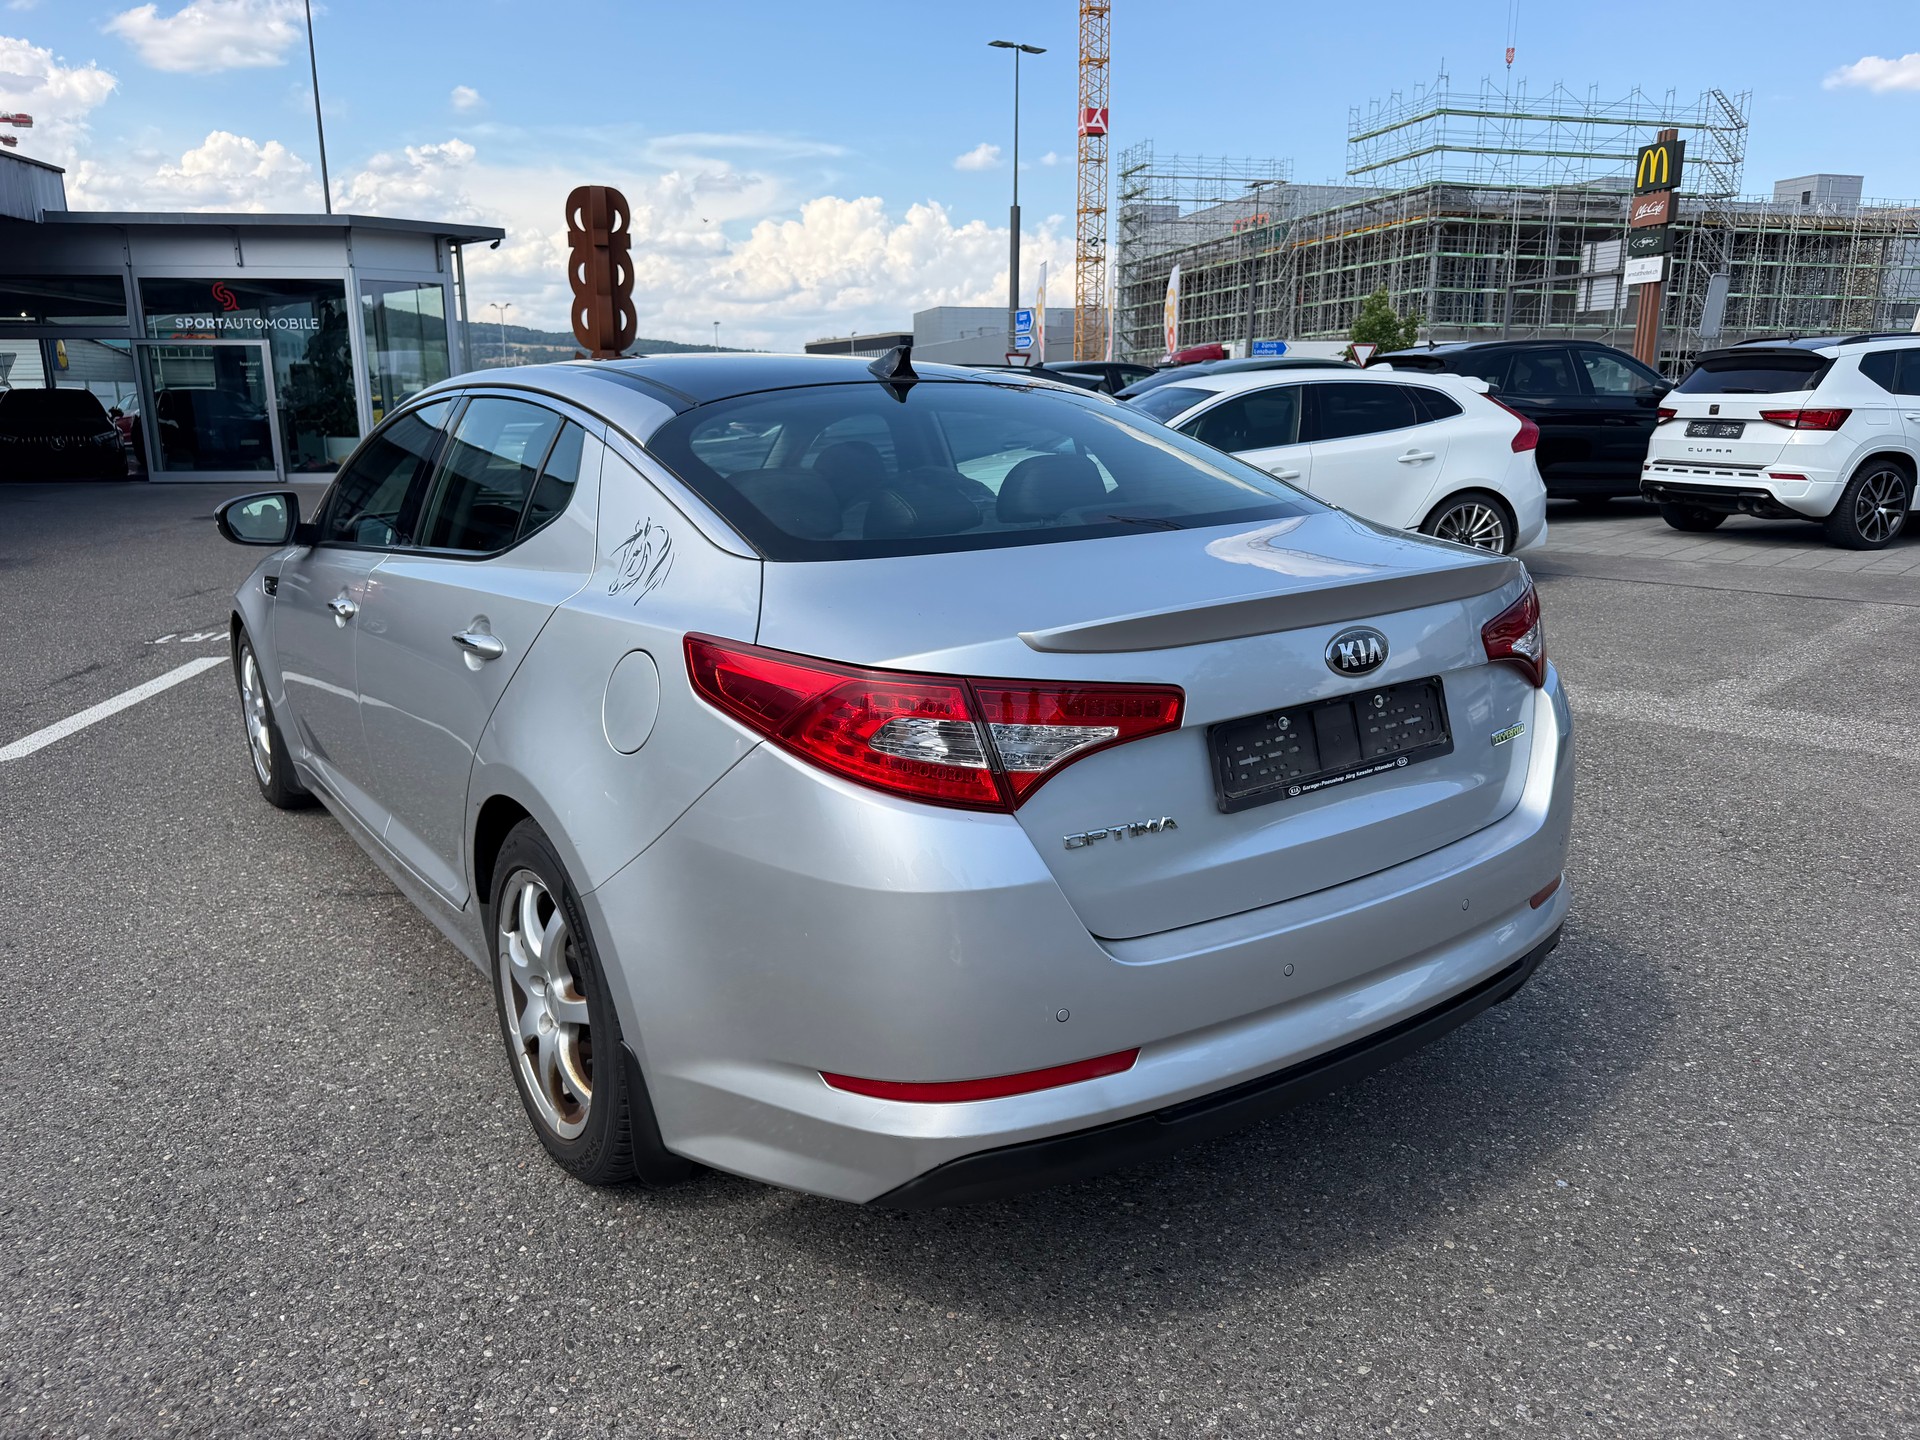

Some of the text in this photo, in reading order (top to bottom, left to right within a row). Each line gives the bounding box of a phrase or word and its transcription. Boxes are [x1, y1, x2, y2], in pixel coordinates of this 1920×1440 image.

[175, 317, 320, 330] SPORTAUTOMOBILE
[1337, 637, 1383, 668] KIA
[1063, 817, 1178, 850] OPTIMA
